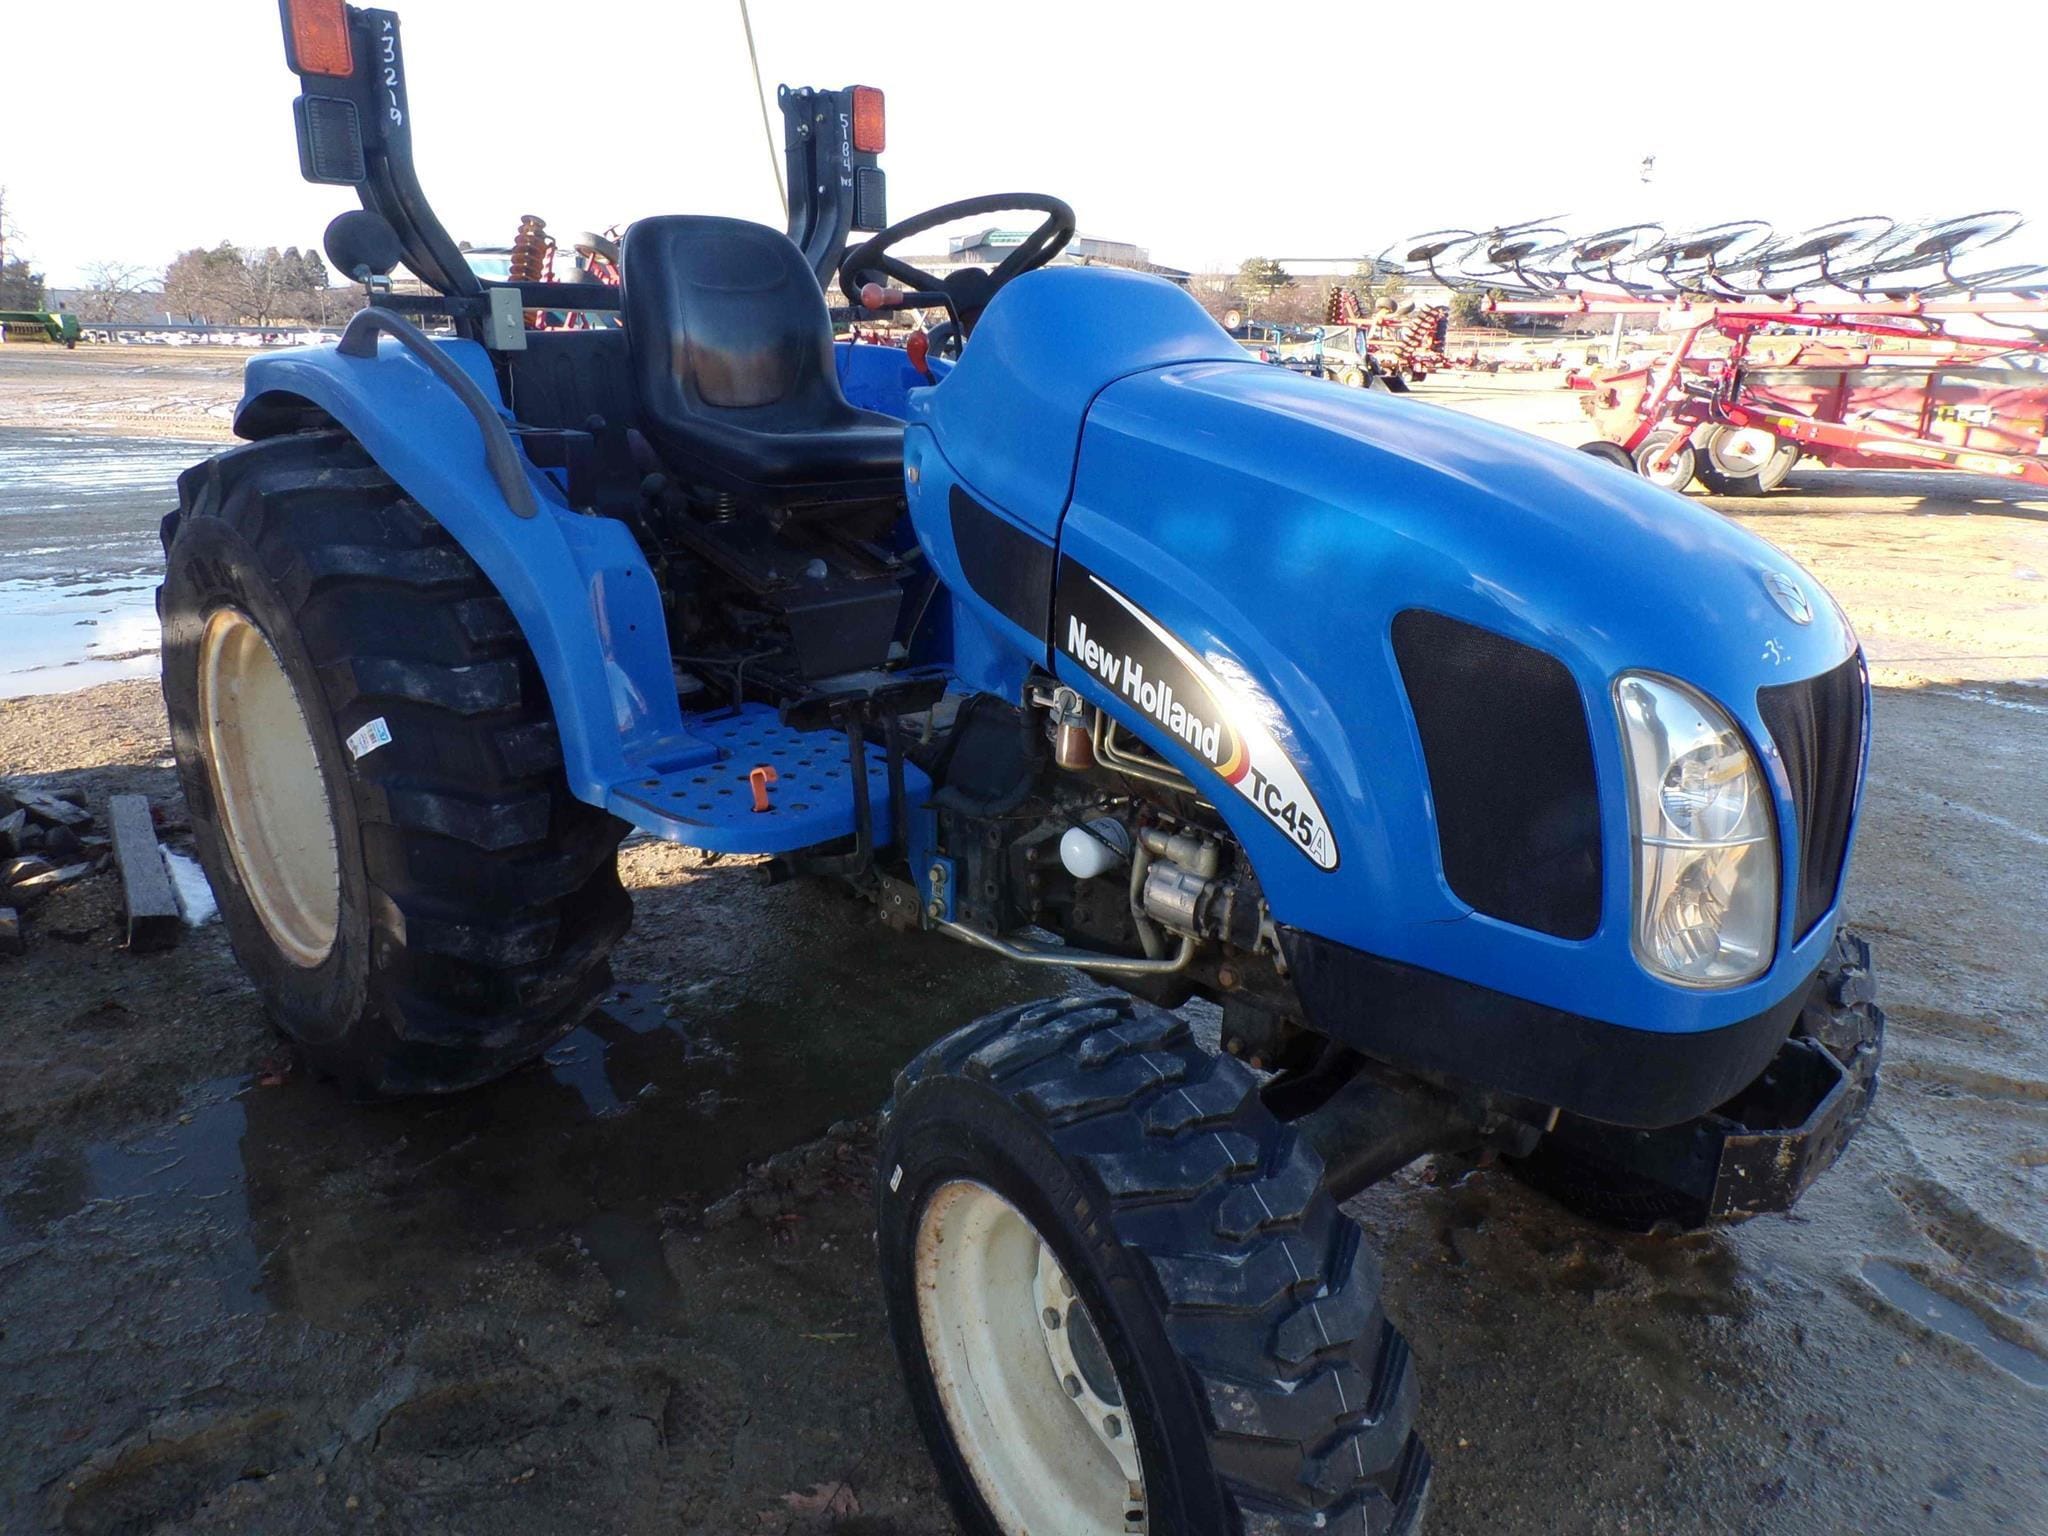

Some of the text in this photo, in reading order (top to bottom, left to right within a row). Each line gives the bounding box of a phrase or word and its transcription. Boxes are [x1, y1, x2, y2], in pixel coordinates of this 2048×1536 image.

[839, 112, 852, 173] 5184
[1068, 614, 1222, 764] New Holland
[1250, 768, 1327, 866] TC45A
